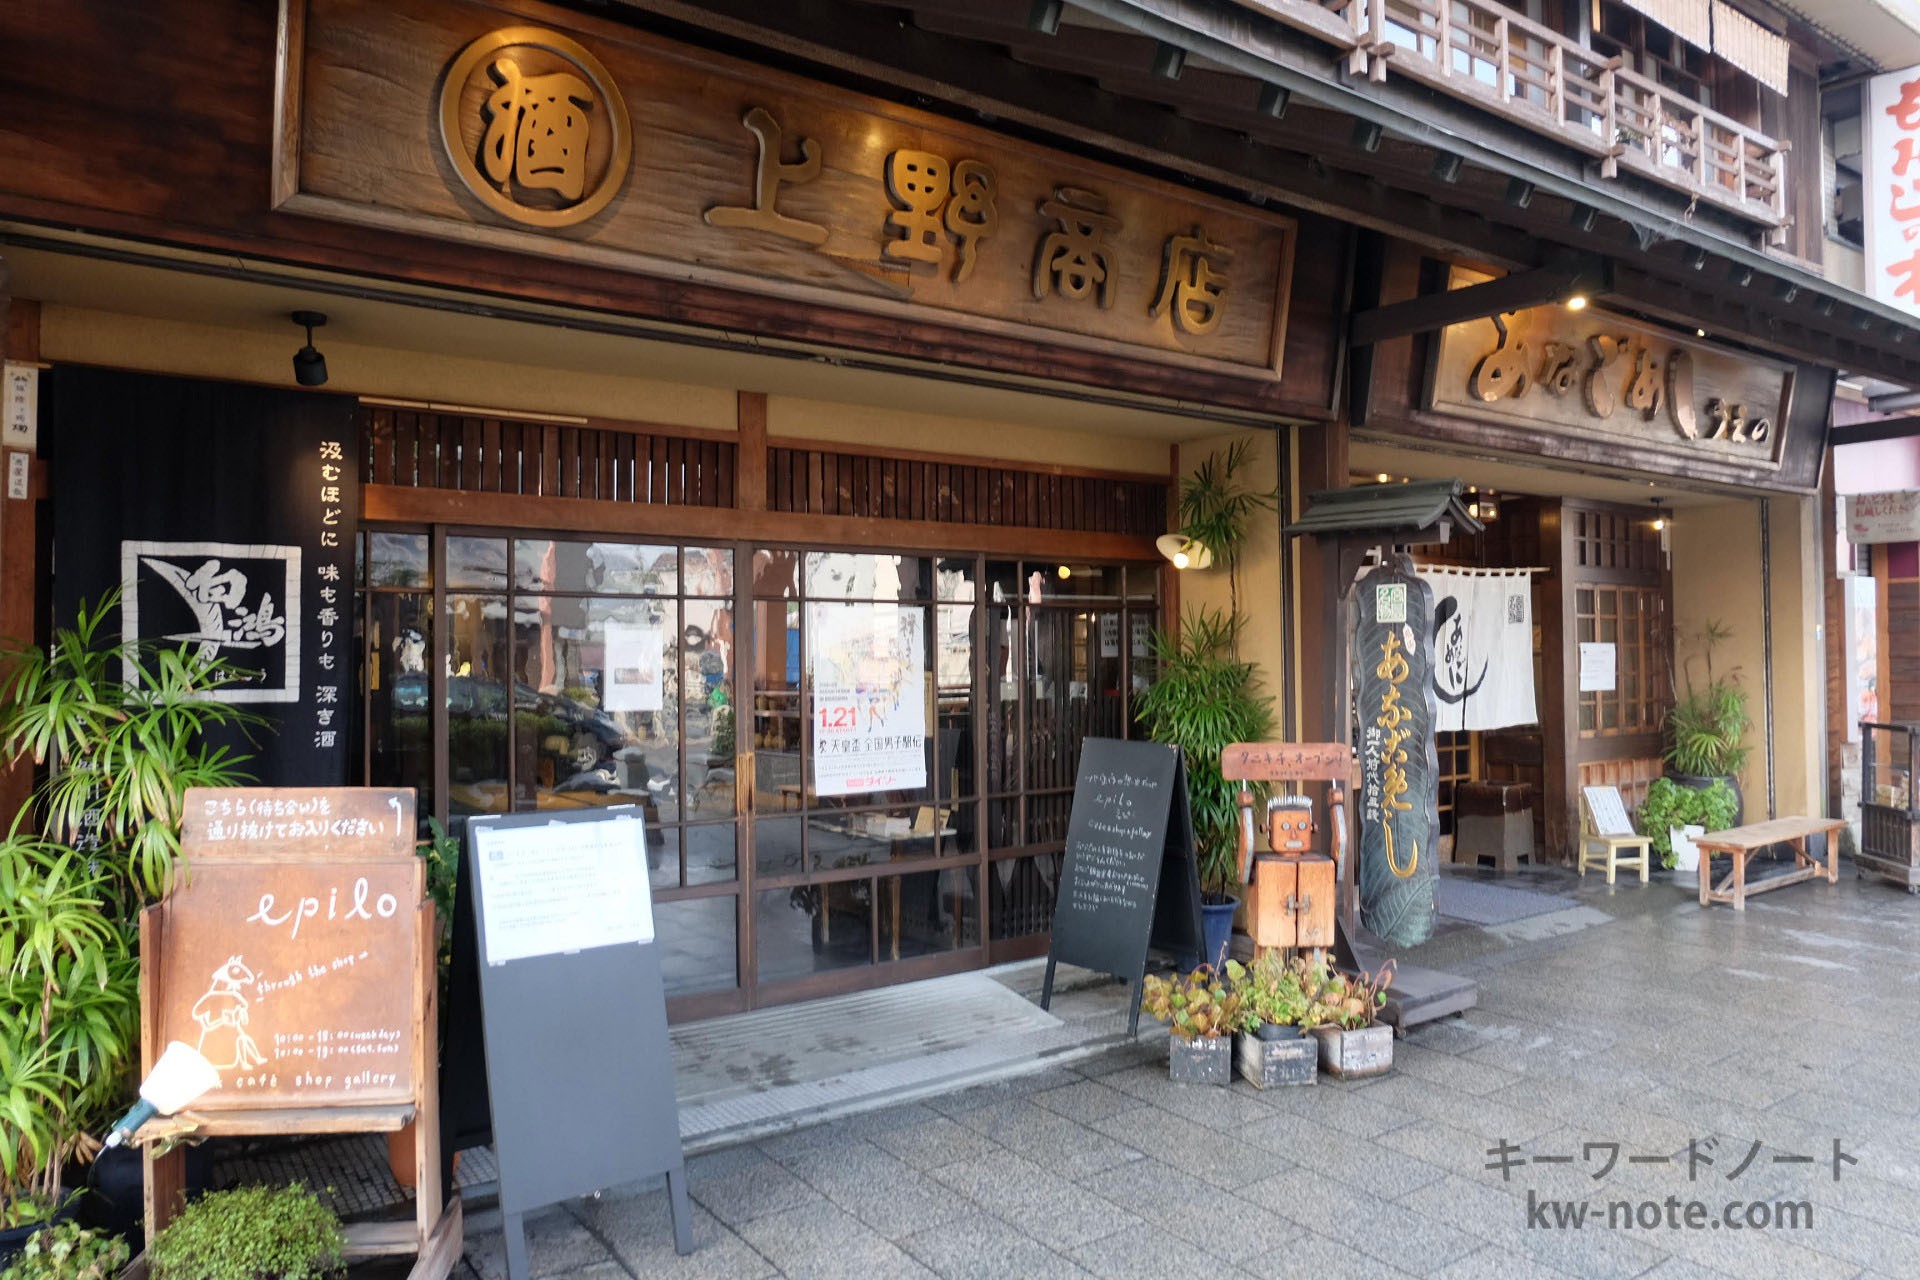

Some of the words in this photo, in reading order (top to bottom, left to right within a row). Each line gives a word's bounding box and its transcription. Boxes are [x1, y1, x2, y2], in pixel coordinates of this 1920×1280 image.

[703, 106, 1236, 336] 上野商店
[319, 440, 344, 548] 汲むほどに
[316, 563, 341, 670] 味も香りも
[313, 685, 339, 748] 深き酒
[818, 706, 857, 727] 1.21
[246, 877, 397, 940] epilo
[295, 1071, 333, 1088] shop
[344, 1070, 396, 1089] gallery
